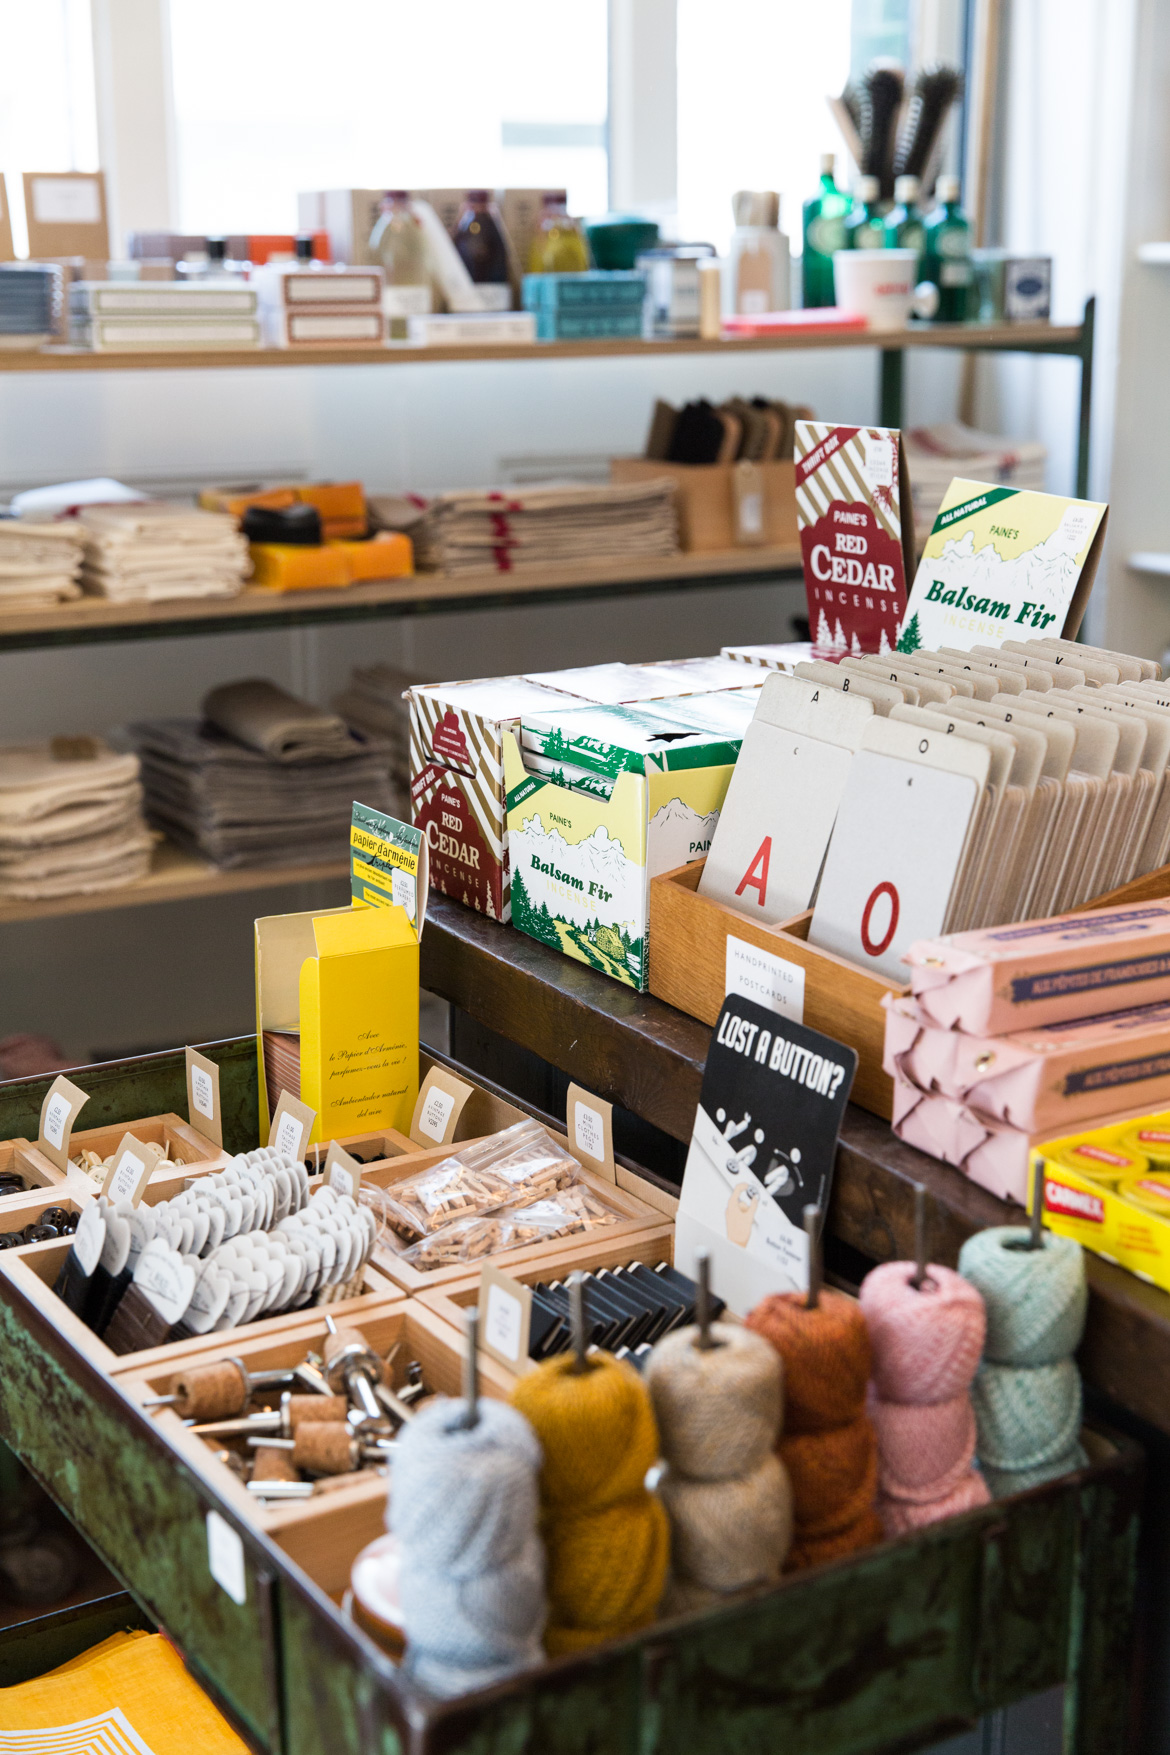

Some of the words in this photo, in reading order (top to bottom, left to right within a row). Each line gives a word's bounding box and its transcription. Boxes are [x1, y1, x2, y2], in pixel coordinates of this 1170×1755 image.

[801, 446, 825, 474] THRIFT
[823, 434, 840, 455] BOX
[833, 510, 868, 527] PAINE'S
[940, 512, 954, 525] ALL
[953, 496, 988, 520] NATURAL
[835, 532, 868, 555] RED
[989, 525, 1020, 540] PAINE'S
[810, 544, 897, 593] CEDAR
[814, 587, 900, 615] INCENSE
[924, 579, 1012, 620] Balsam
[1014, 601, 1057, 630] Fir
[943, 612, 1006, 639] INCENSE
[842, 678, 850, 692] B
[810, 691, 819, 703] A
[946, 723, 955, 734] P
[918, 739, 929, 753] O
[411, 776, 427, 797] THRIFT
[425, 769, 436, 785] BOX
[514, 792, 522, 803] ALL
[521, 781, 537, 797] NATURAL
[441, 793, 461, 808] PAINE'S
[441, 811, 463, 833] RED
[549, 812, 572, 829] PAINE'S
[353, 832, 378, 851] papier
[377, 842, 416, 870] d'arménie
[425, 819, 481, 870] CEDAR
[689, 839, 712, 853] PAIN
[430, 856, 480, 888] INCENSE
[530, 853, 585, 891] Balsam
[587, 880, 613, 902] Fir
[734, 835, 772, 907] A
[546, 879, 597, 912] INCENSE
[861, 881, 900, 957] O
[734, 949, 794, 984] HANDPRINTED
[739, 975, 788, 1005] POSTCARDS
[357, 1030, 379, 1041] Avec
[337, 1050, 363, 1061] Papier
[382, 1059, 389, 1067] la
[716, 1011, 760, 1057] LOST
[754, 1029, 772, 1065] A
[768, 1035, 846, 1100] BUTTON?
[330, 1092, 380, 1108] Ambientador
[381, 1085, 409, 1099] natural
[356, 1108, 367, 1118] del
[368, 1108, 382, 1116] aire
[577, 1123, 599, 1140] CLOTHES
[582, 1133, 595, 1144] PEGS
